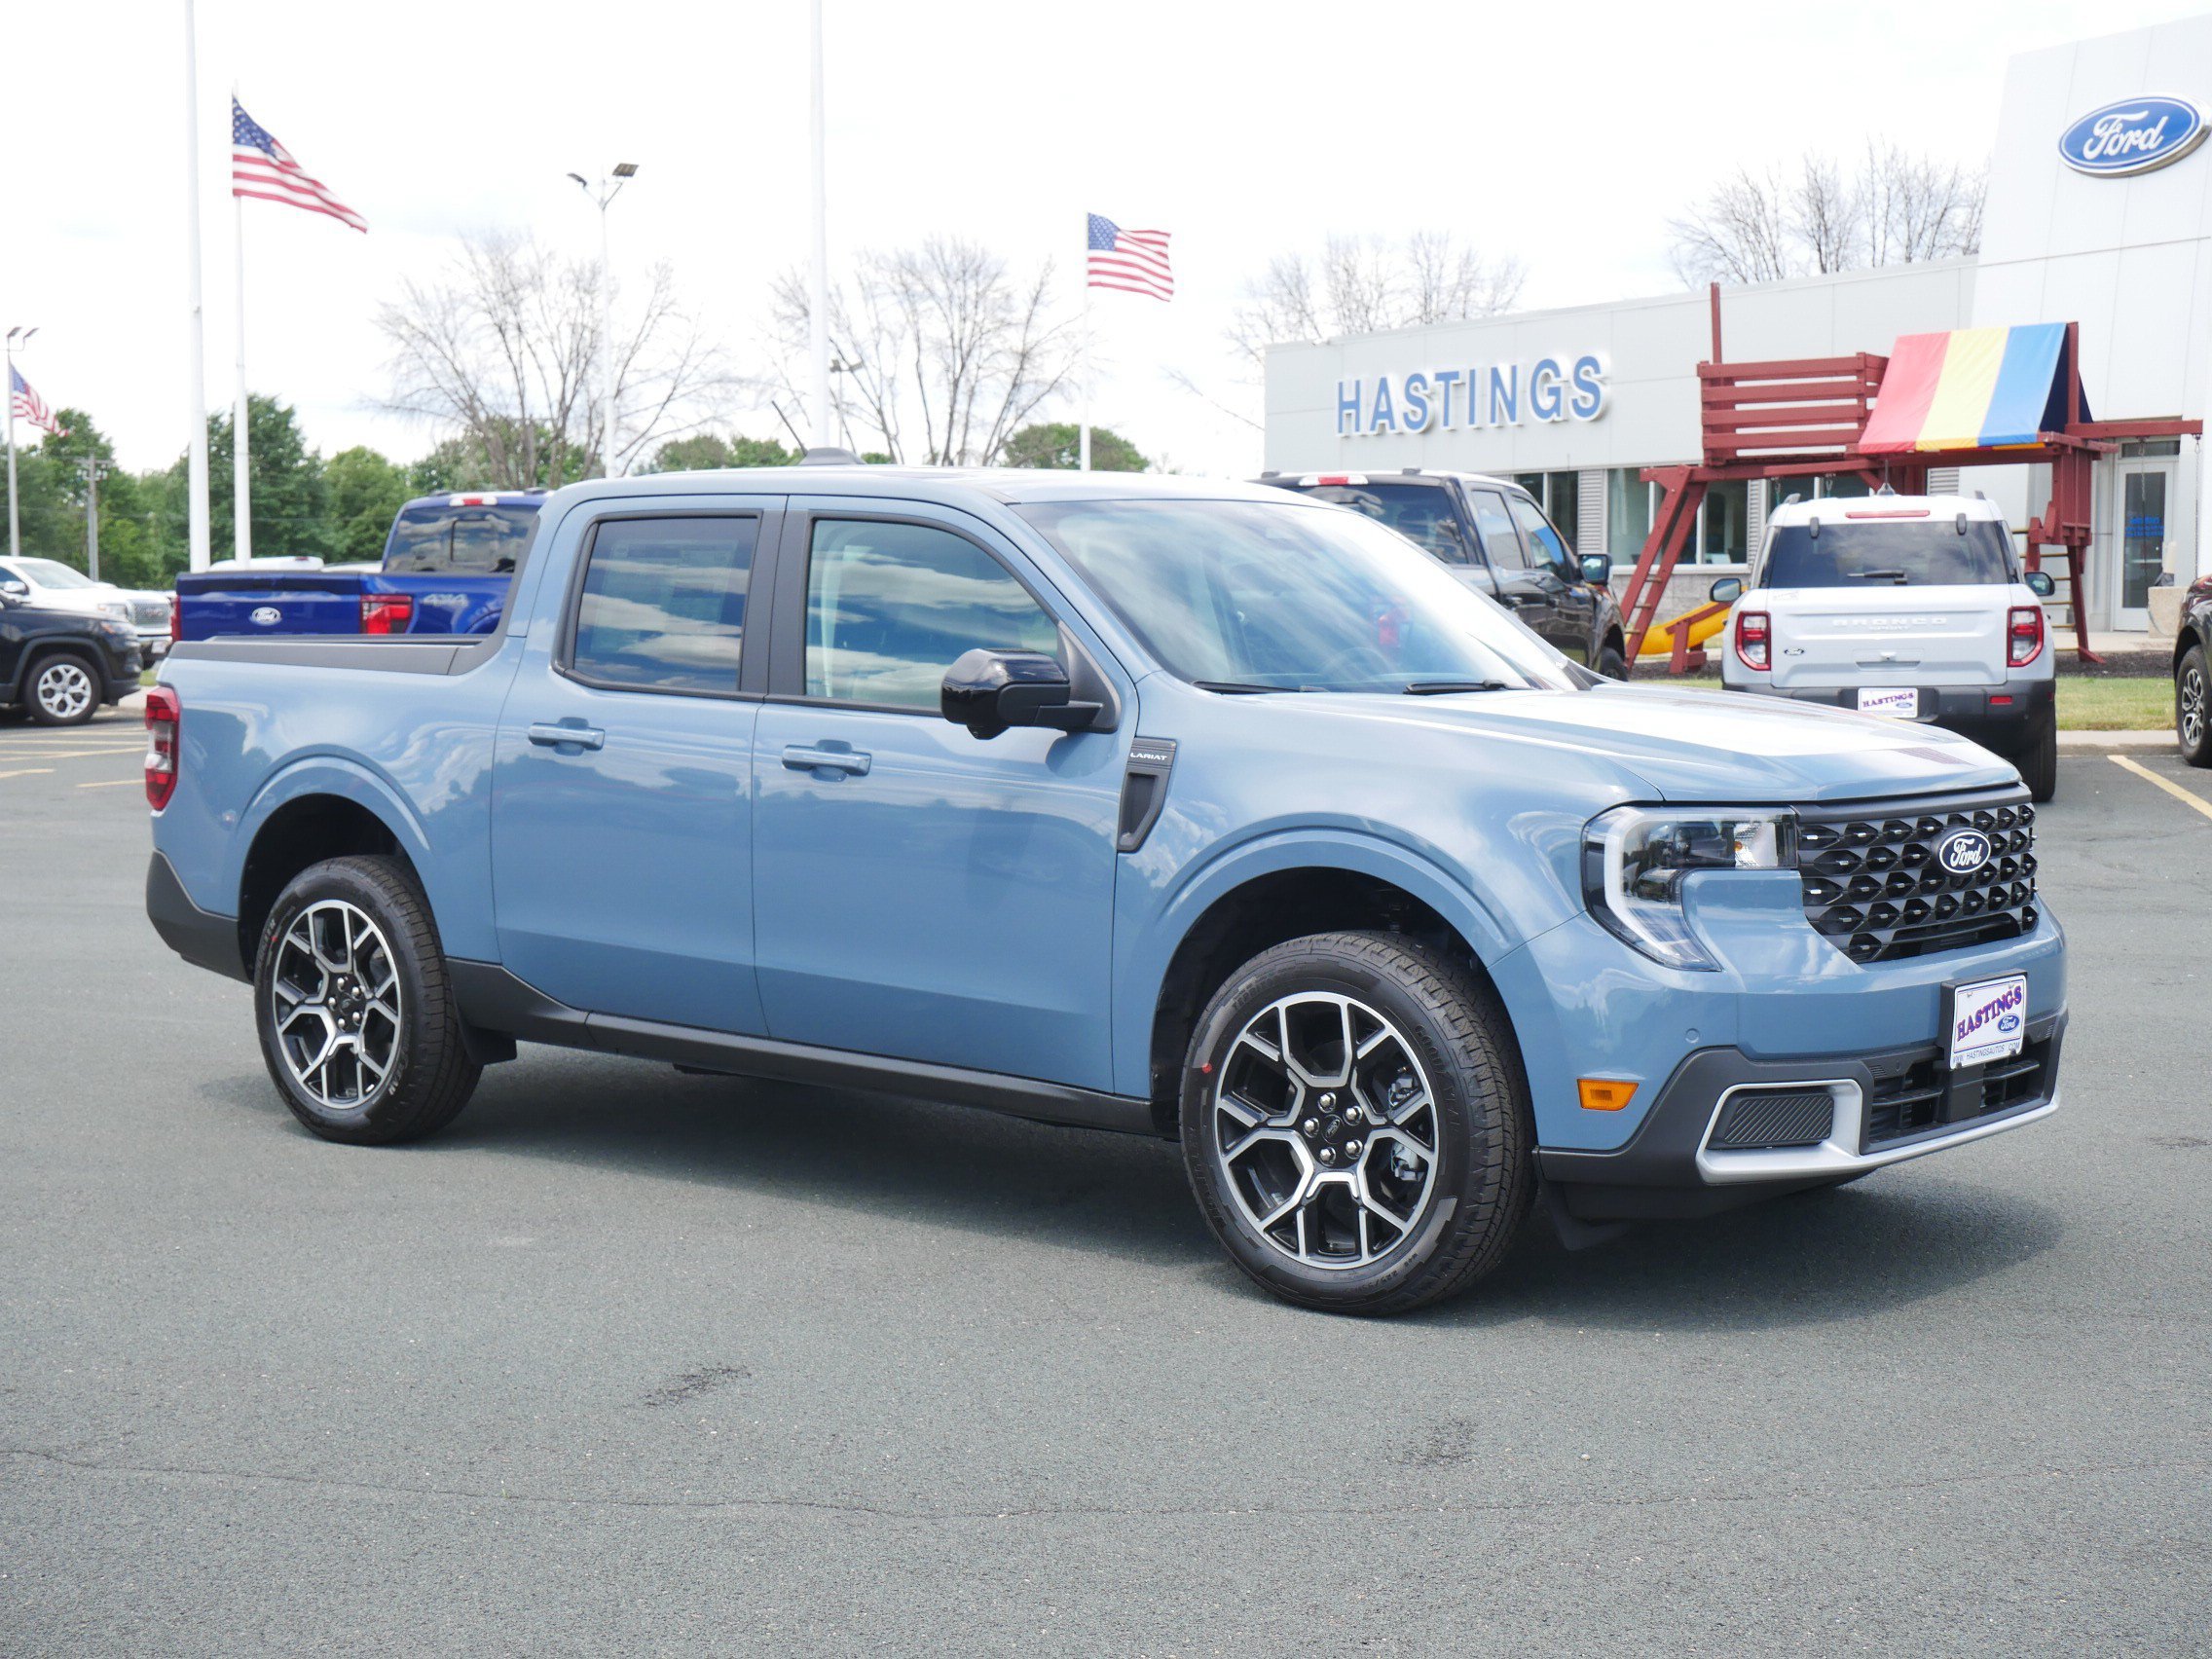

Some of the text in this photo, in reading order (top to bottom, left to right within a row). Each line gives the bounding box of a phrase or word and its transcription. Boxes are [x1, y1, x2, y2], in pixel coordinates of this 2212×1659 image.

[2083, 110, 2168, 160] Ford
[1336, 354, 1604, 434] HASTINGS
[1832, 616, 1947, 626] BRONCO
[1862, 692, 1914, 708] HASTINGS
[1129, 752, 1167, 760] LARIAT
[1950, 837, 1983, 866] Ford
[1957, 985, 2022, 1042] HASTINGS
